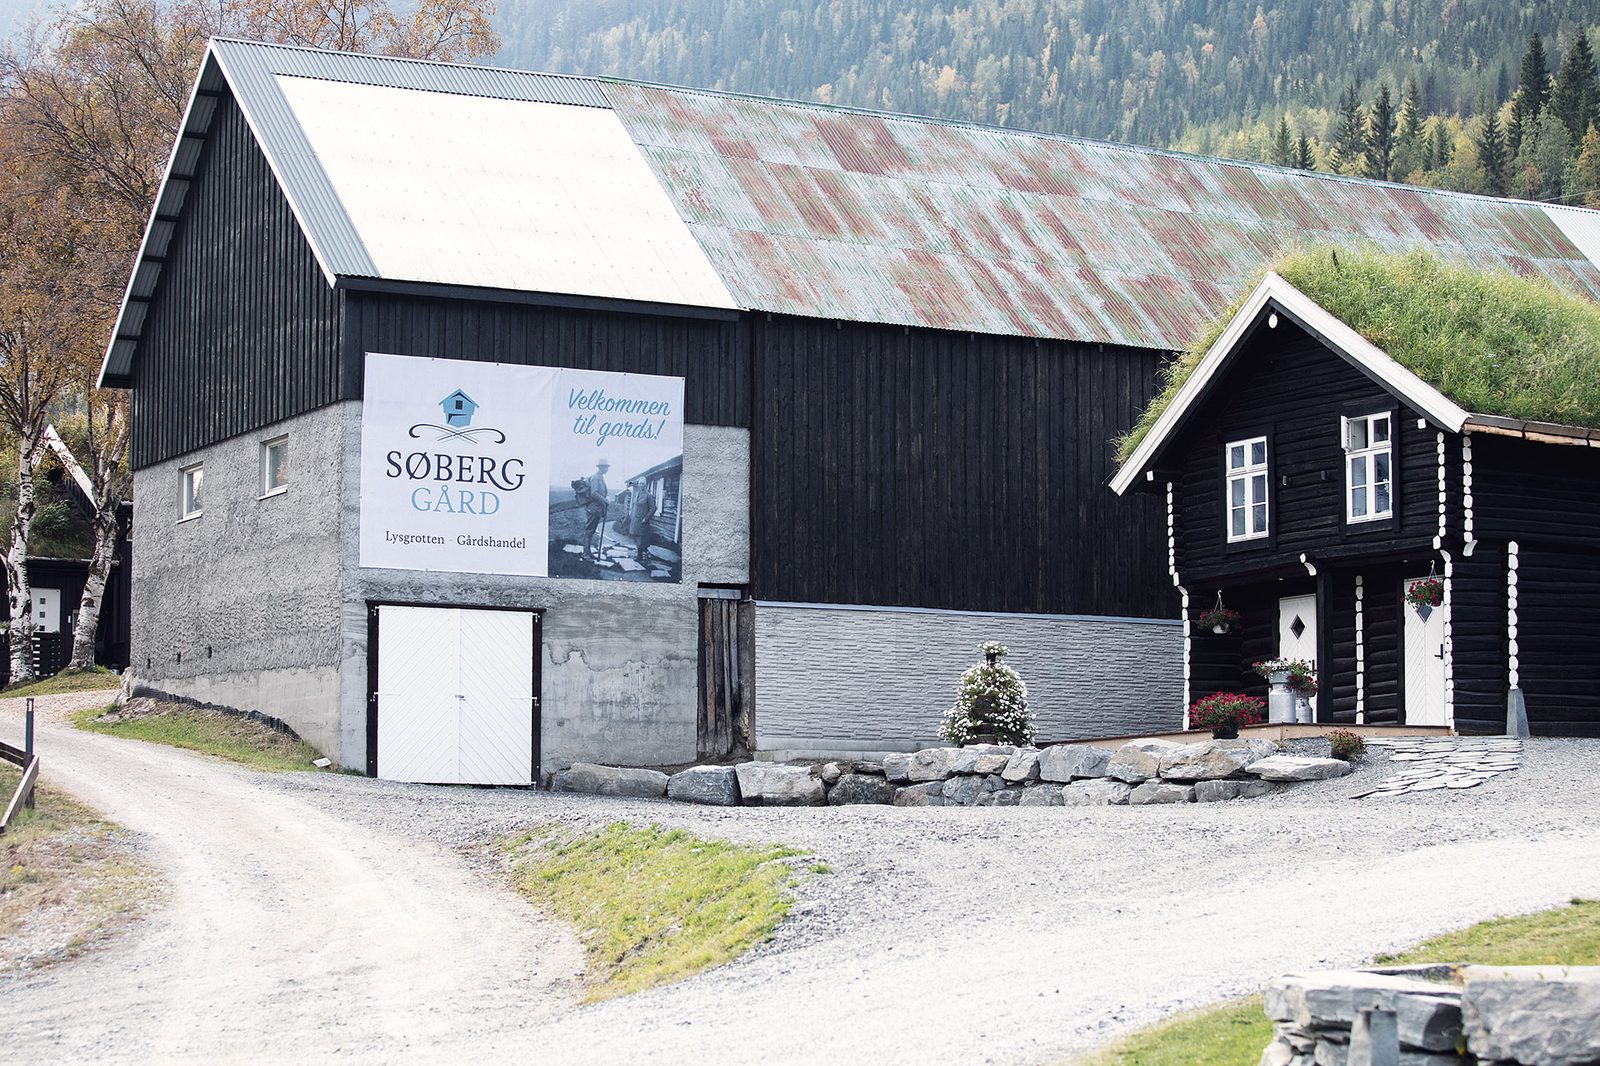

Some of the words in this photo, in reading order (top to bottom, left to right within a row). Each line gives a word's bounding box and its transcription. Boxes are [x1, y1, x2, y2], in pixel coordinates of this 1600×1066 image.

[568, 388, 671, 417] Velkommen
[573, 414, 595, 435] til
[596, 418, 666, 447] gards!
[386, 450, 526, 492] SØBERG
[411, 485, 501, 515] GÅRD
[385, 530, 445, 545] Lysgrotten
[456, 534, 526, 549] Gårdshandel
